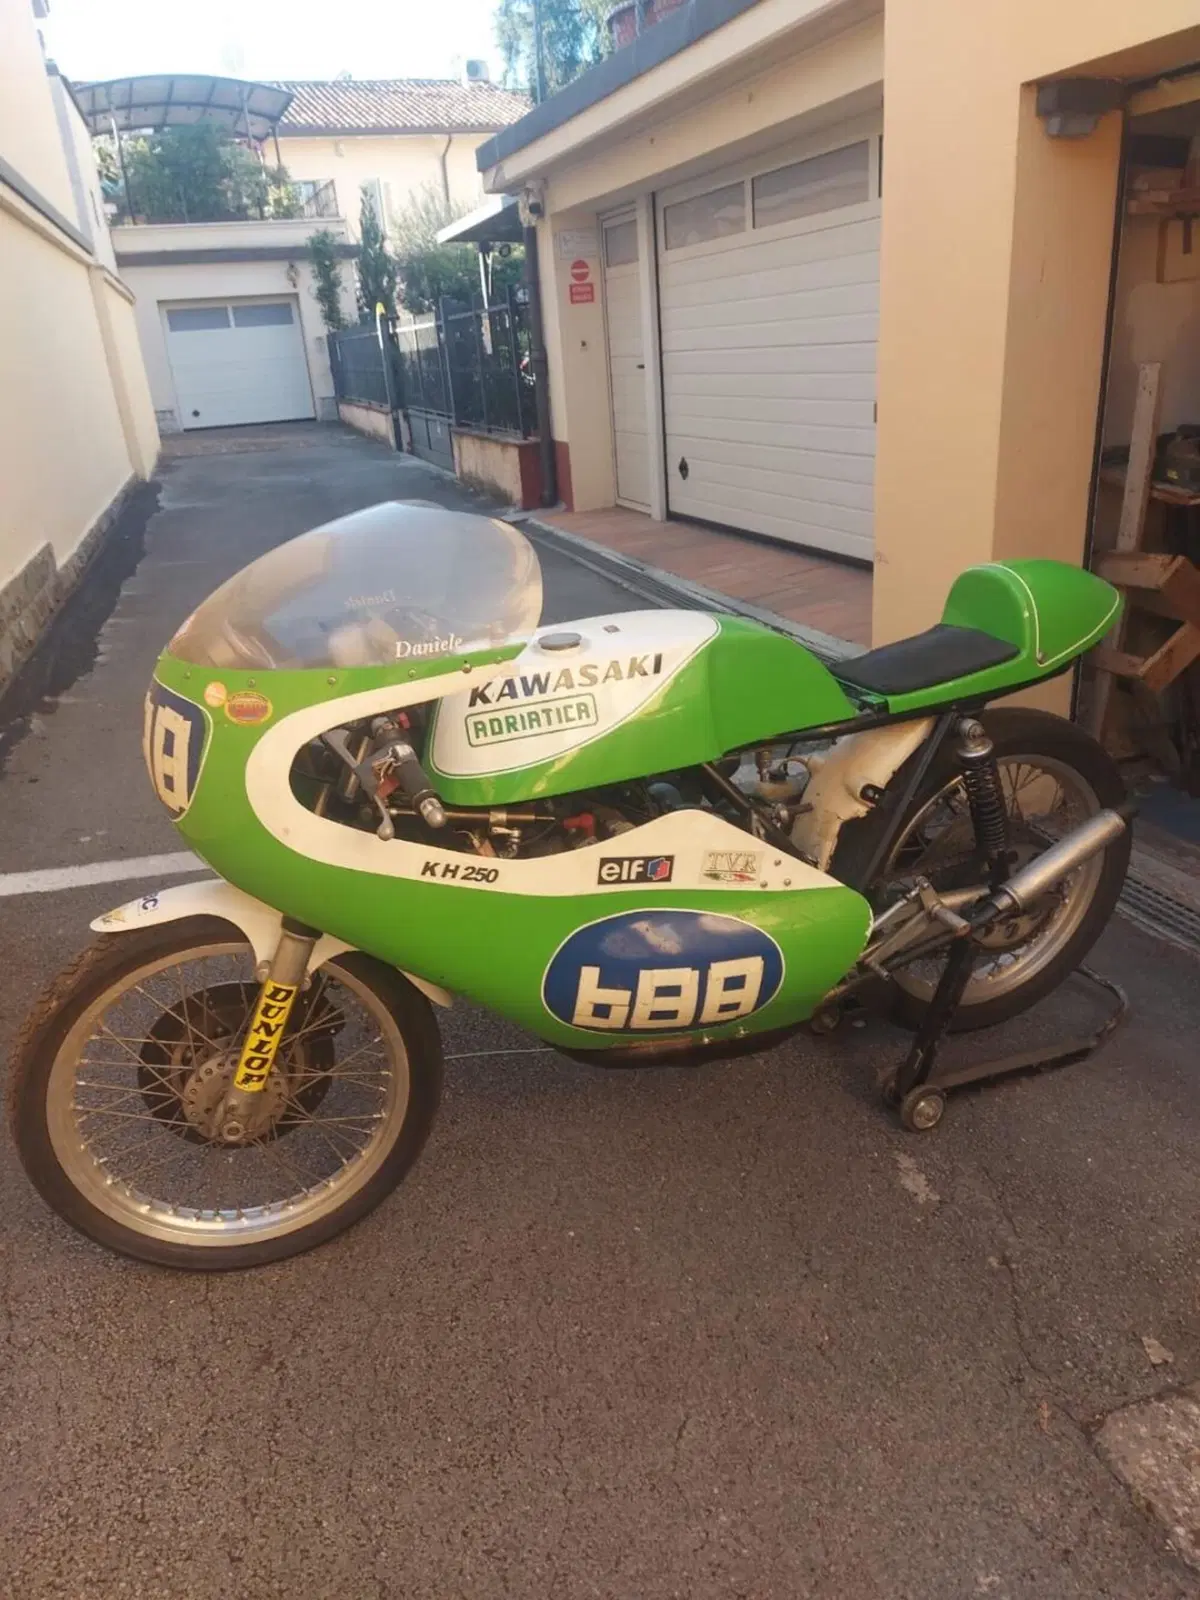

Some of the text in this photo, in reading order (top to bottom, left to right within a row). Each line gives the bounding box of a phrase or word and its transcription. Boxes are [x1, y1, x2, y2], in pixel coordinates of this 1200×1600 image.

[395, 633, 463, 658] Daniele
[468, 653, 663, 707] KAWASAKI
[473, 701, 591, 739] ADRIATICA
[601, 859, 645, 882] elf
[708, 851, 757, 873] TVR
[572, 955, 765, 1029] 688
[236, 986, 294, 1085] DUNLOP
